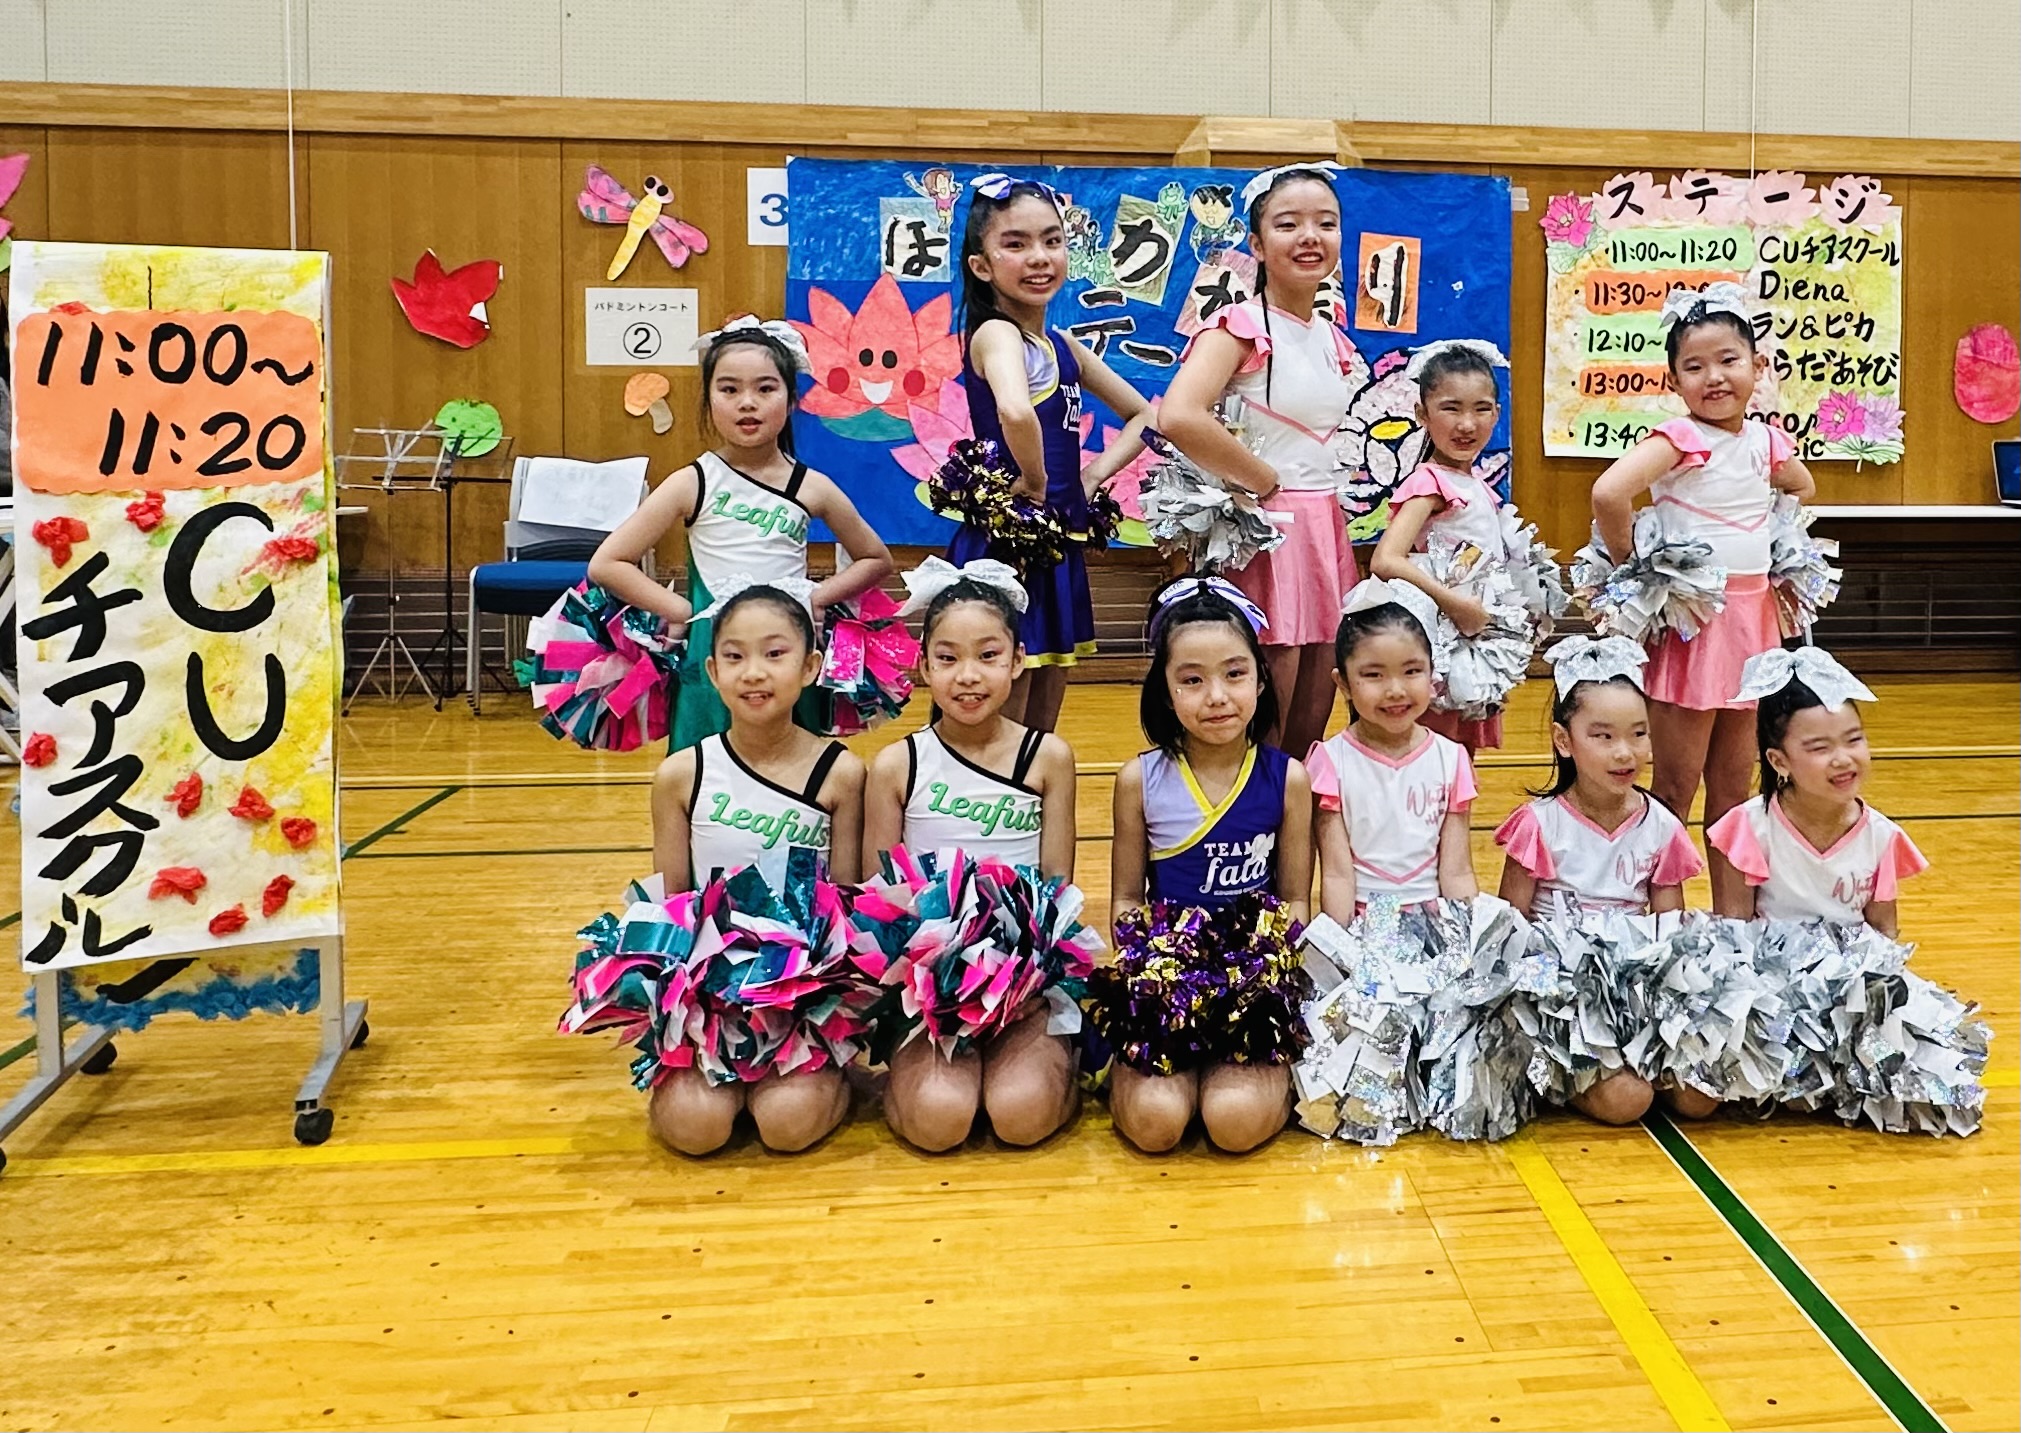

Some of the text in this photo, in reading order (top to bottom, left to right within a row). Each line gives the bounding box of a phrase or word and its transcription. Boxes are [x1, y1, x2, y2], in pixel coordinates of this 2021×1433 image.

[760, 193, 789, 227] 3
[1608, 178, 1878, 224] ステージ
[1612, 238, 1737, 264] 11:00~11:20
[1759, 234, 1900, 267] CUチアスクール
[1759, 270, 1849, 303] Diena
[594, 302, 688, 313] バドミントンコート
[1765, 349, 1899, 387] らだあそび
[99, 408, 306, 477] 11:20
[163, 501, 287, 762] CU
[21, 550, 161, 965] チアスクール
[709, 792, 829, 850] Leafuls
